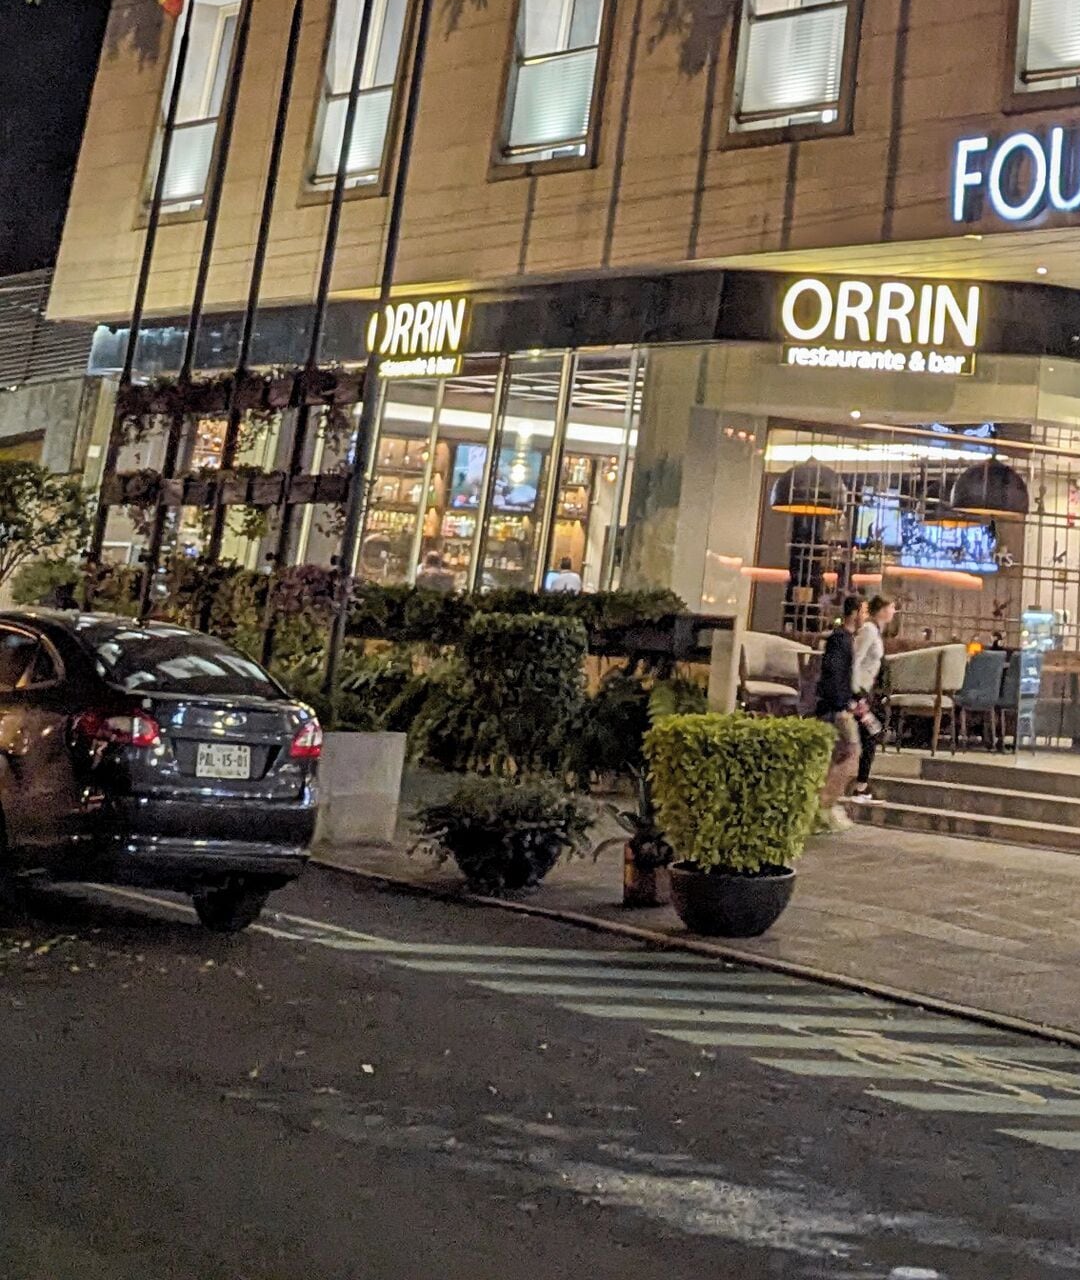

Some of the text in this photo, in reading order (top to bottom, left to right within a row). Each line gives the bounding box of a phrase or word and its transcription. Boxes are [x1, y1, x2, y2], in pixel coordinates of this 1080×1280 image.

[367, 297, 466, 355] ORRIN
[782, 278, 980, 347] ORRIN
[788, 345, 966, 375] restaurante & bar
